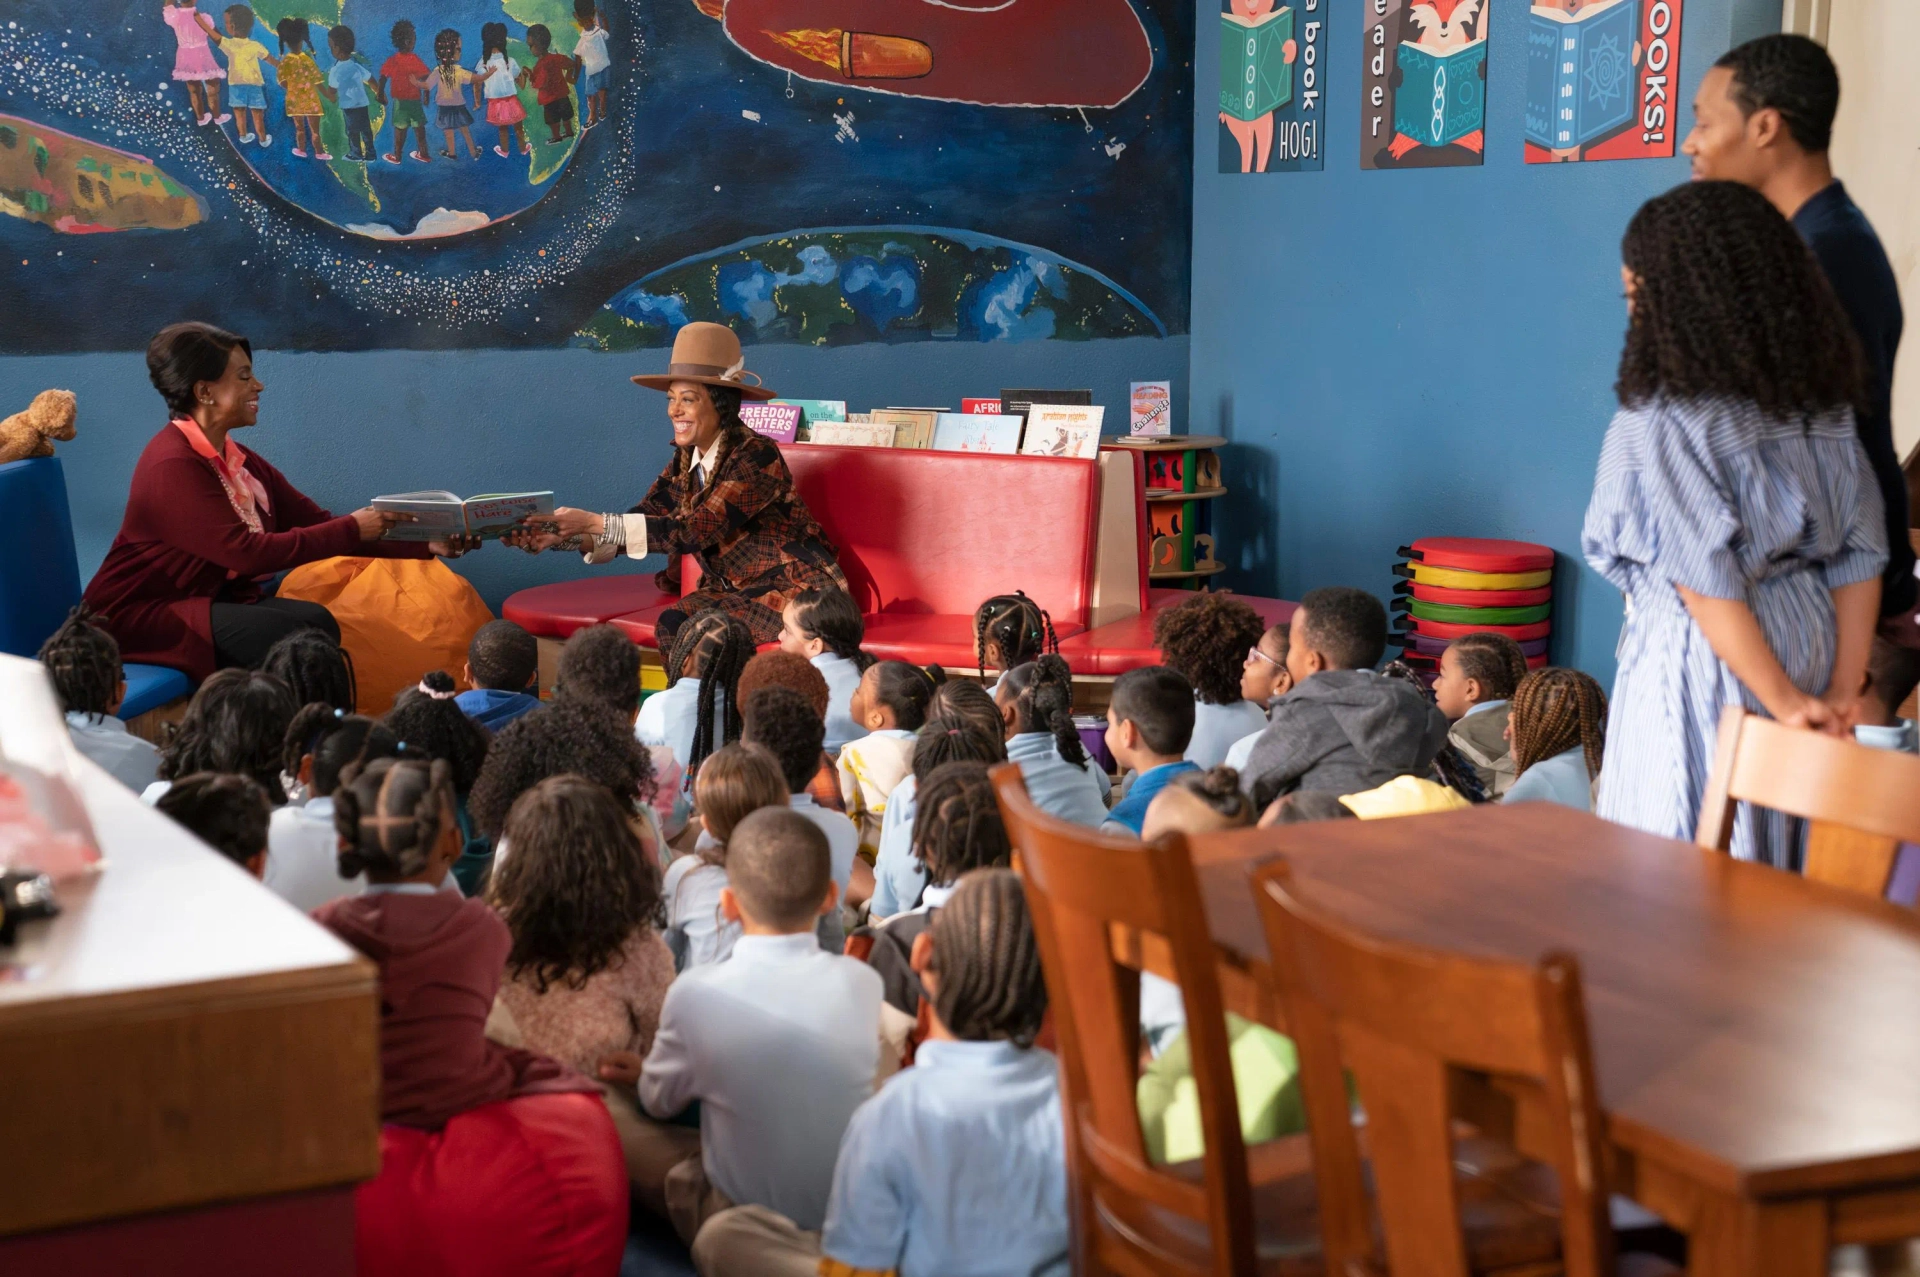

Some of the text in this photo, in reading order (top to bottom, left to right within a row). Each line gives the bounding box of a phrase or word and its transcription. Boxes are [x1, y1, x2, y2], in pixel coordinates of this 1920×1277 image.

[1303, 22, 1321, 110] book
[1642, 1, 1671, 143] OOKS!
[1280, 119, 1317, 160] HOG!
[738, 407, 797, 421] FREEDOM
[820, 411, 833, 419] the
[1132, 400, 1169, 431] Challenge
[741, 418, 794, 431] IGHTERS
[958, 420, 999, 431] Fairy Tale
[474, 509, 512, 519] Hare
